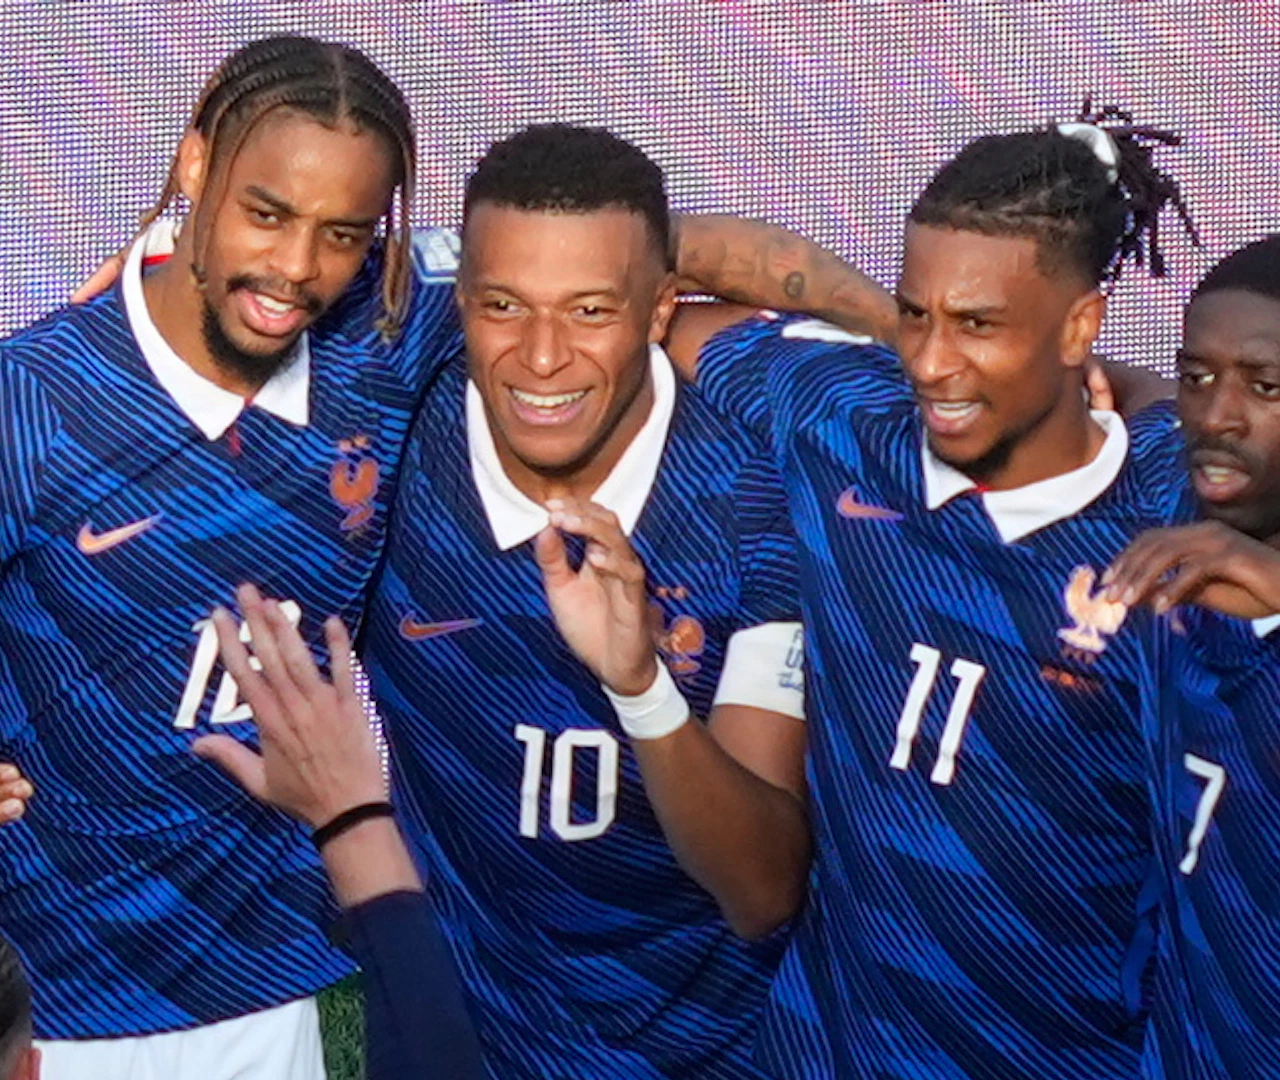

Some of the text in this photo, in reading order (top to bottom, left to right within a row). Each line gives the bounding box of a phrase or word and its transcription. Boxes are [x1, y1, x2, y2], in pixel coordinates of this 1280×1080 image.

[889, 641, 986, 786] 11
[514, 722, 618, 841] 10
[1179, 752, 1225, 875] 7
